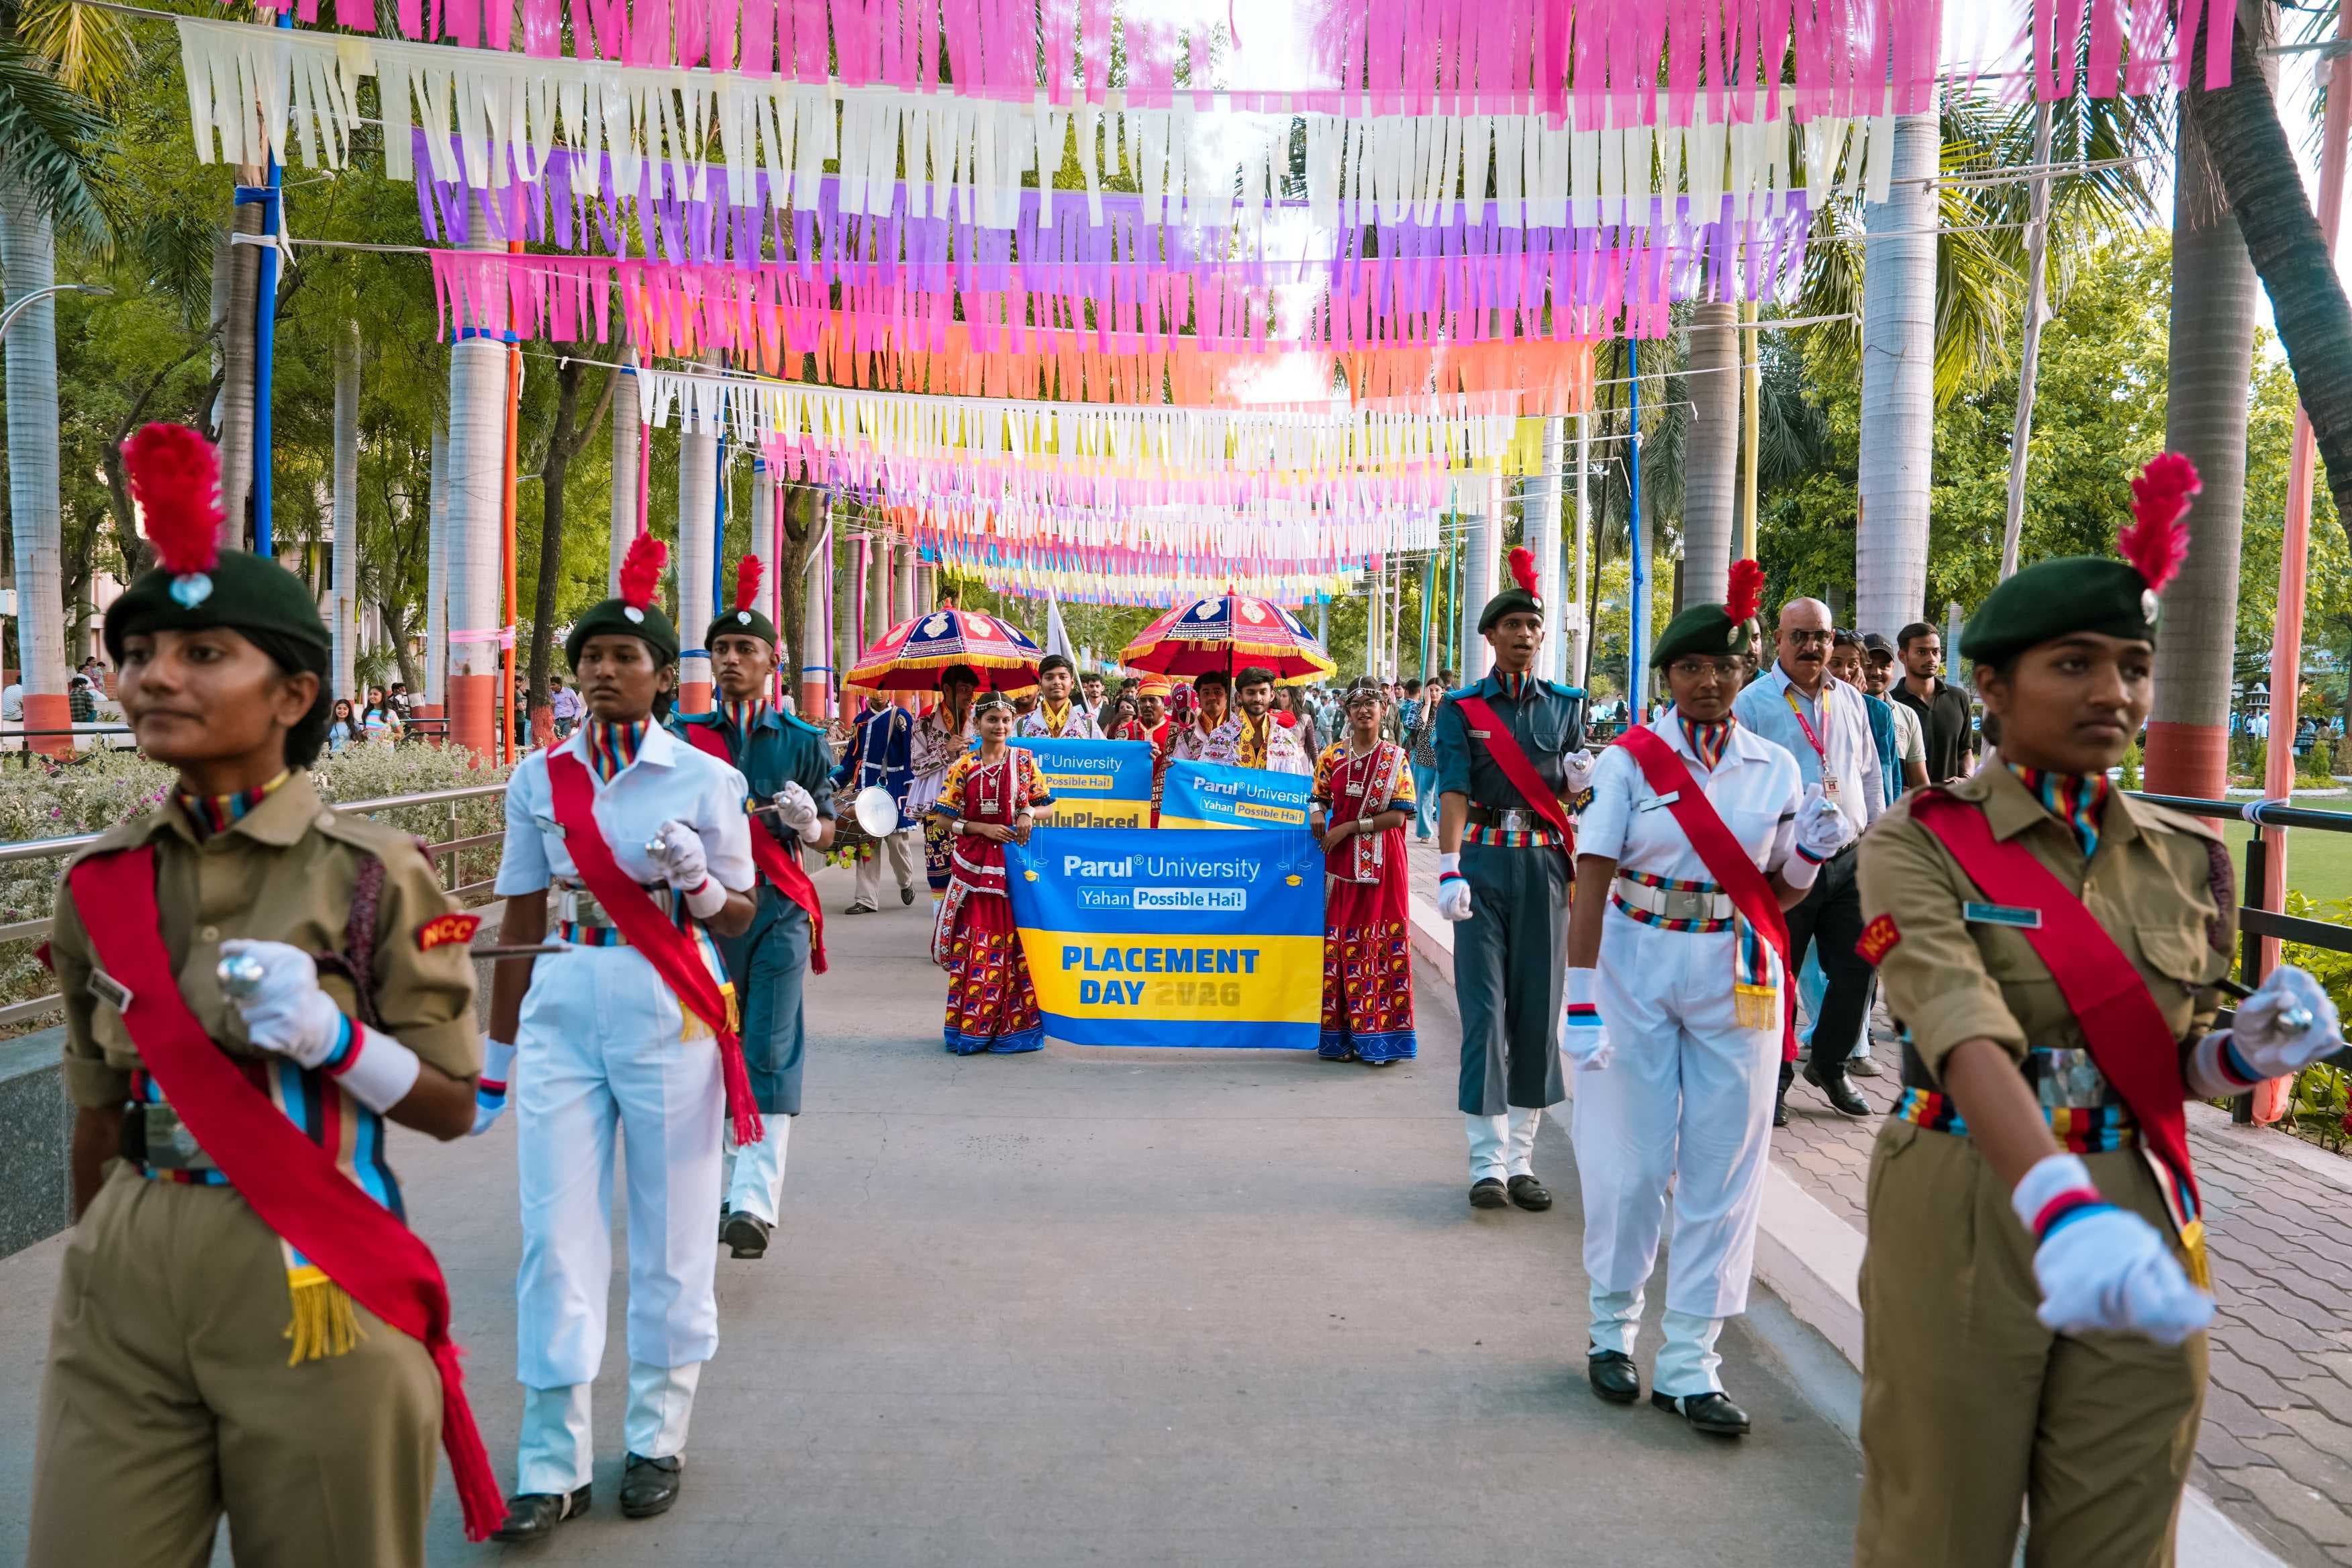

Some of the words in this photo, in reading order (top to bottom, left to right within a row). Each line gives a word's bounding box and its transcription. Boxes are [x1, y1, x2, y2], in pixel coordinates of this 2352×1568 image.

[1052, 754, 1123, 773] University
[1045, 776, 1087, 786] Possible
[1089, 779, 1110, 787] Hai!
[1246, 783, 1310, 806] Universit
[1204, 799, 1233, 812] Yahan
[1237, 805, 1279, 819] Possible
[1281, 811, 1302, 822] Hai!
[1147, 856, 1261, 883] University
[1081, 890, 1130, 905] Yahan
[1138, 891, 1204, 907] Possible
[1208, 892, 1241, 907] Hai!
[423, 918, 472, 948] NCC
[1062, 946, 1260, 973] PLACEMENT
[1079, 979, 1146, 1006] DAY
